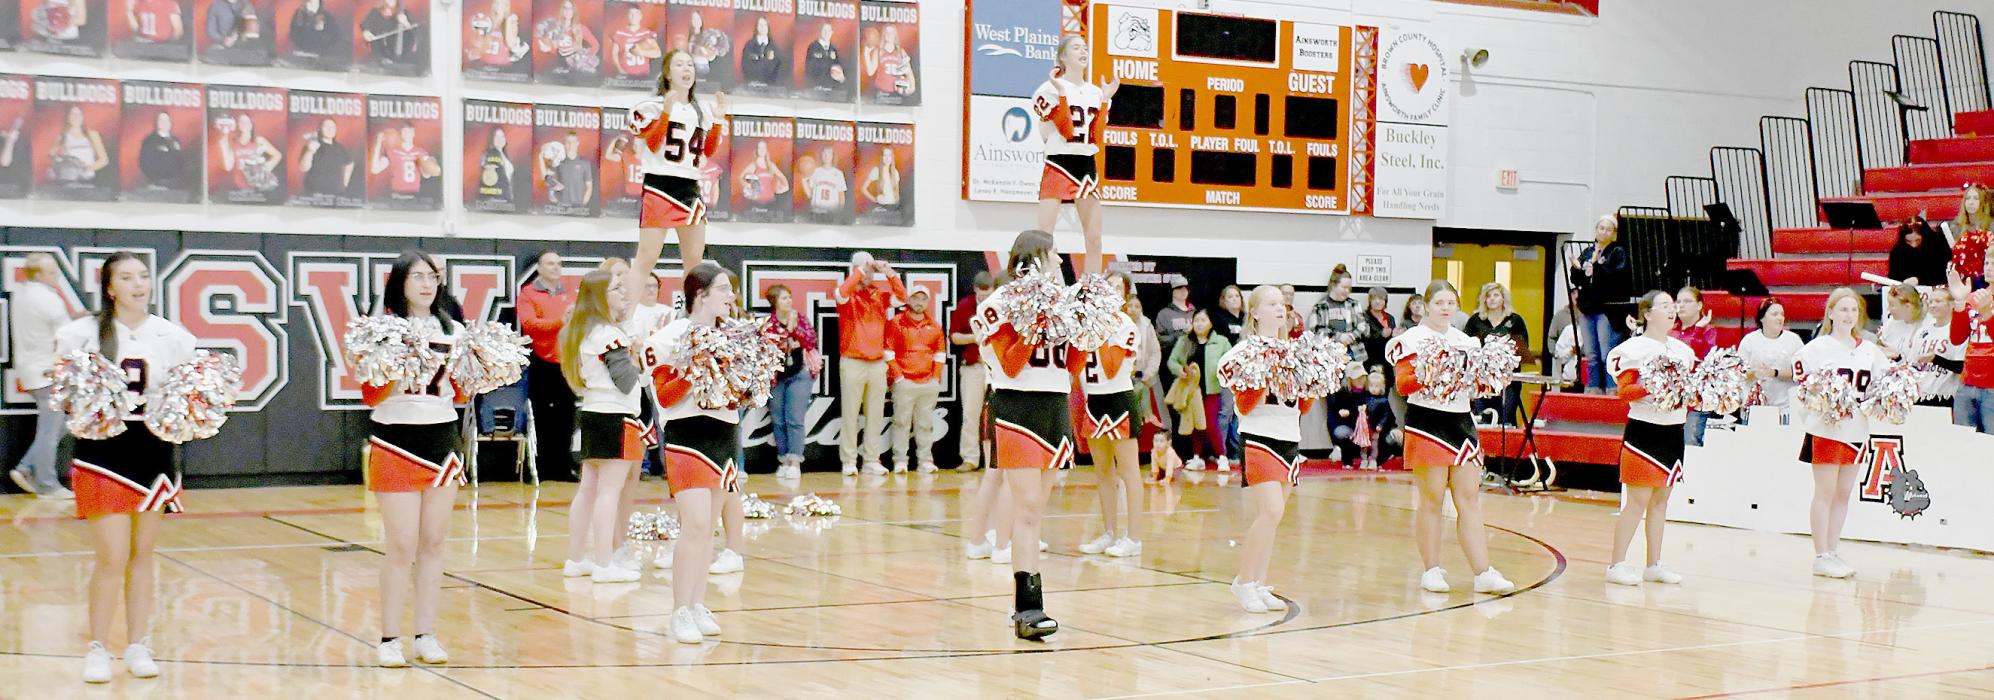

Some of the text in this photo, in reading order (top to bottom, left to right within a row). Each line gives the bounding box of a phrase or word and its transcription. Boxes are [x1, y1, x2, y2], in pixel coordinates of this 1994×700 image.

[798, 4, 856, 19] BULLDOGS
[861, 6, 918, 23] BULLDOGS
[975, 23, 1060, 46] West Plains
[1295, 35, 1338, 47] AINSWORTH
[1025, 44, 1058, 60] Bank
[1299, 48, 1333, 59] BOOSTERS
[1381, 32, 1447, 76] BROWN COUNTY HOSPITAL
[1113, 59, 1158, 80] HOME
[1207, 77, 1244, 93] PERIOD
[1287, 72, 1336, 95] GUEST
[36, 81, 117, 104] BULLDOGS
[124, 85, 201, 108] BULLDOGS
[208, 90, 284, 112] BULLDOGS
[290, 95, 362, 117] BULLDOGS
[369, 100, 439, 120] BULLDOGS
[1410, 108, 1432, 120] FAMILY
[1431, 88, 1446, 112] CLINIC
[466, 104, 532, 126] BULLDOGS
[536, 109, 600, 130] BULLDOGS
[733, 120, 793, 138] BULLDOGS
[797, 123, 854, 142] BULLDOGS
[857, 127, 913, 144] BULLDOGS
[664, 120, 704, 168] 54
[1103, 130, 1138, 146] FOULS
[1149, 133, 1178, 148] T.O.L.
[1190, 136, 1260, 153] PLAYER FOUL
[1386, 128, 1437, 149] Buckley
[1268, 140, 1296, 155] T.O.L.
[1306, 142, 1338, 157] FOULS
[1420, 154, 1445, 170] Inc.
[1501, 169, 1517, 186] EXIT
[1102, 185, 1137, 200] SCORE
[1205, 190, 1240, 205] MATCH
[1376, 187, 1445, 199] For All Your Grain
[1305, 195, 1337, 209] SCORE
[1383, 200, 1440, 211] Handling Needs
